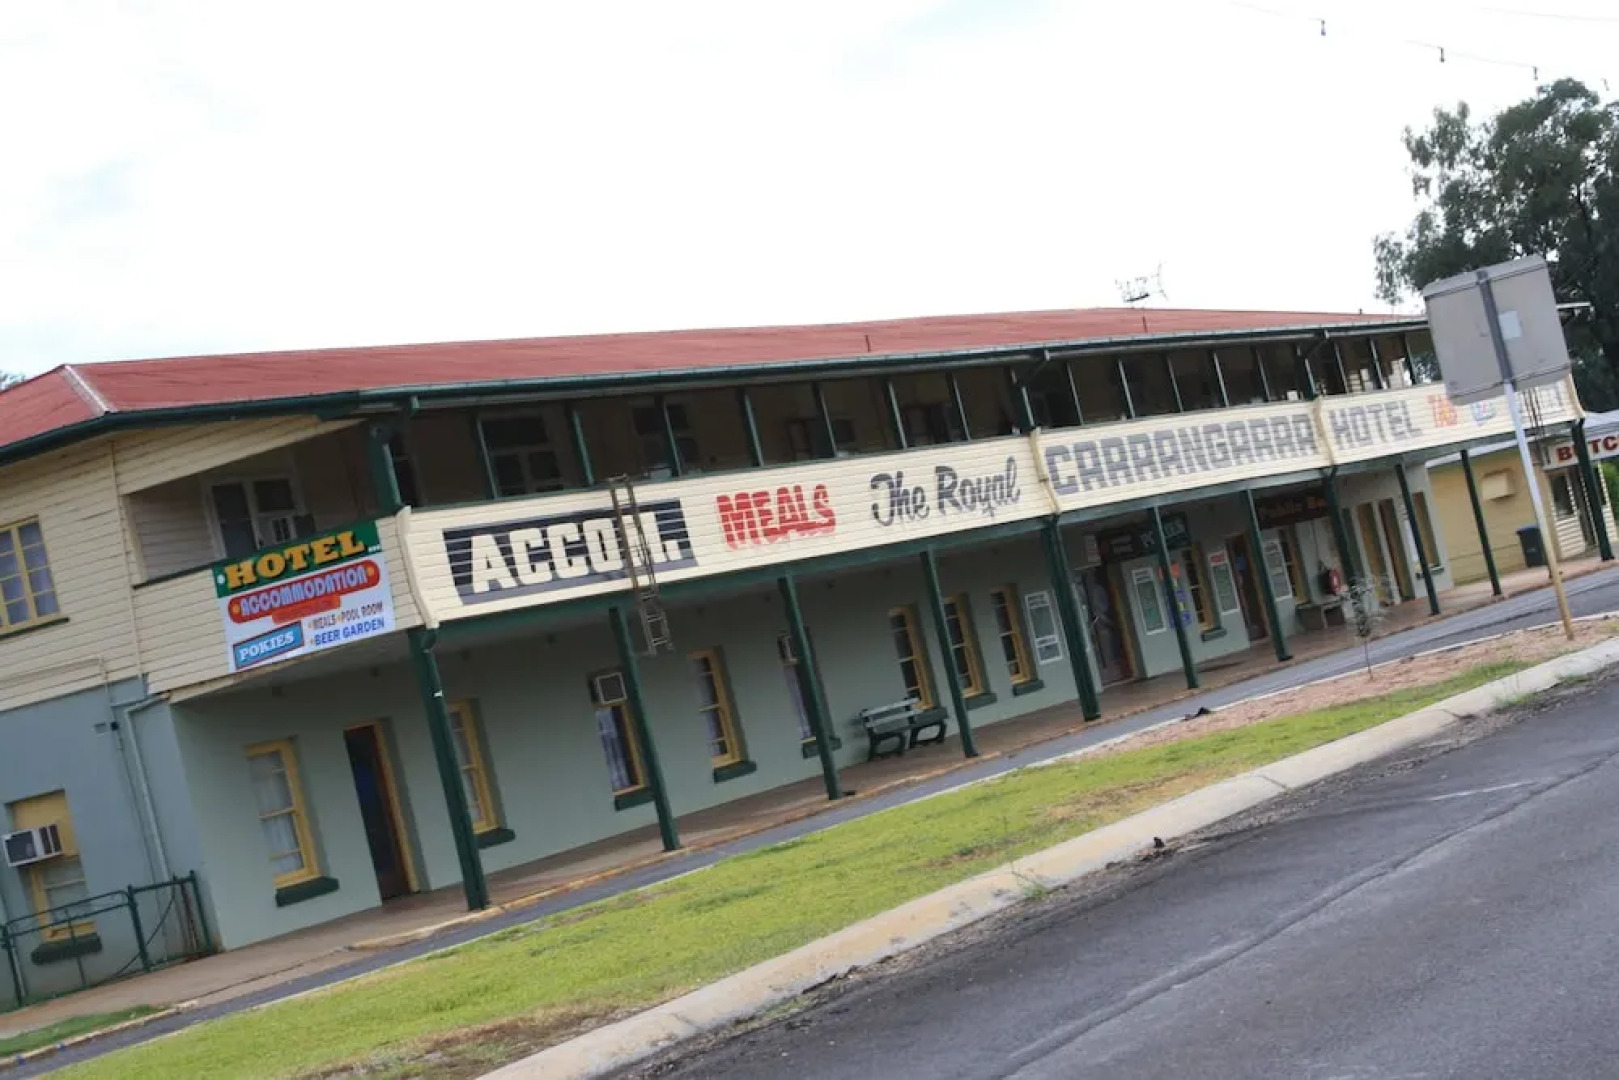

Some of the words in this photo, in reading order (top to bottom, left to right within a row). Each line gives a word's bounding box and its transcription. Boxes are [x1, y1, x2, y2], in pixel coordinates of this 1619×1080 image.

[870, 470, 930, 526] The
[935, 455, 1021, 518] Royal
[1328, 399, 1424, 451] HOTEL
[1556, 436, 1618, 461] BTC
[716, 484, 836, 549] MEALS
[223, 530, 365, 589] HOTEL
[240, 564, 368, 616] ACCOMMODATION
[313, 613, 337, 630] MEALS
[340, 606, 360, 622] POOL
[361, 601, 384, 618] ROOM
[313, 629, 341, 647] BEER
[342, 616, 386, 639] GARDEN
[239, 630, 296, 662] POKIES
